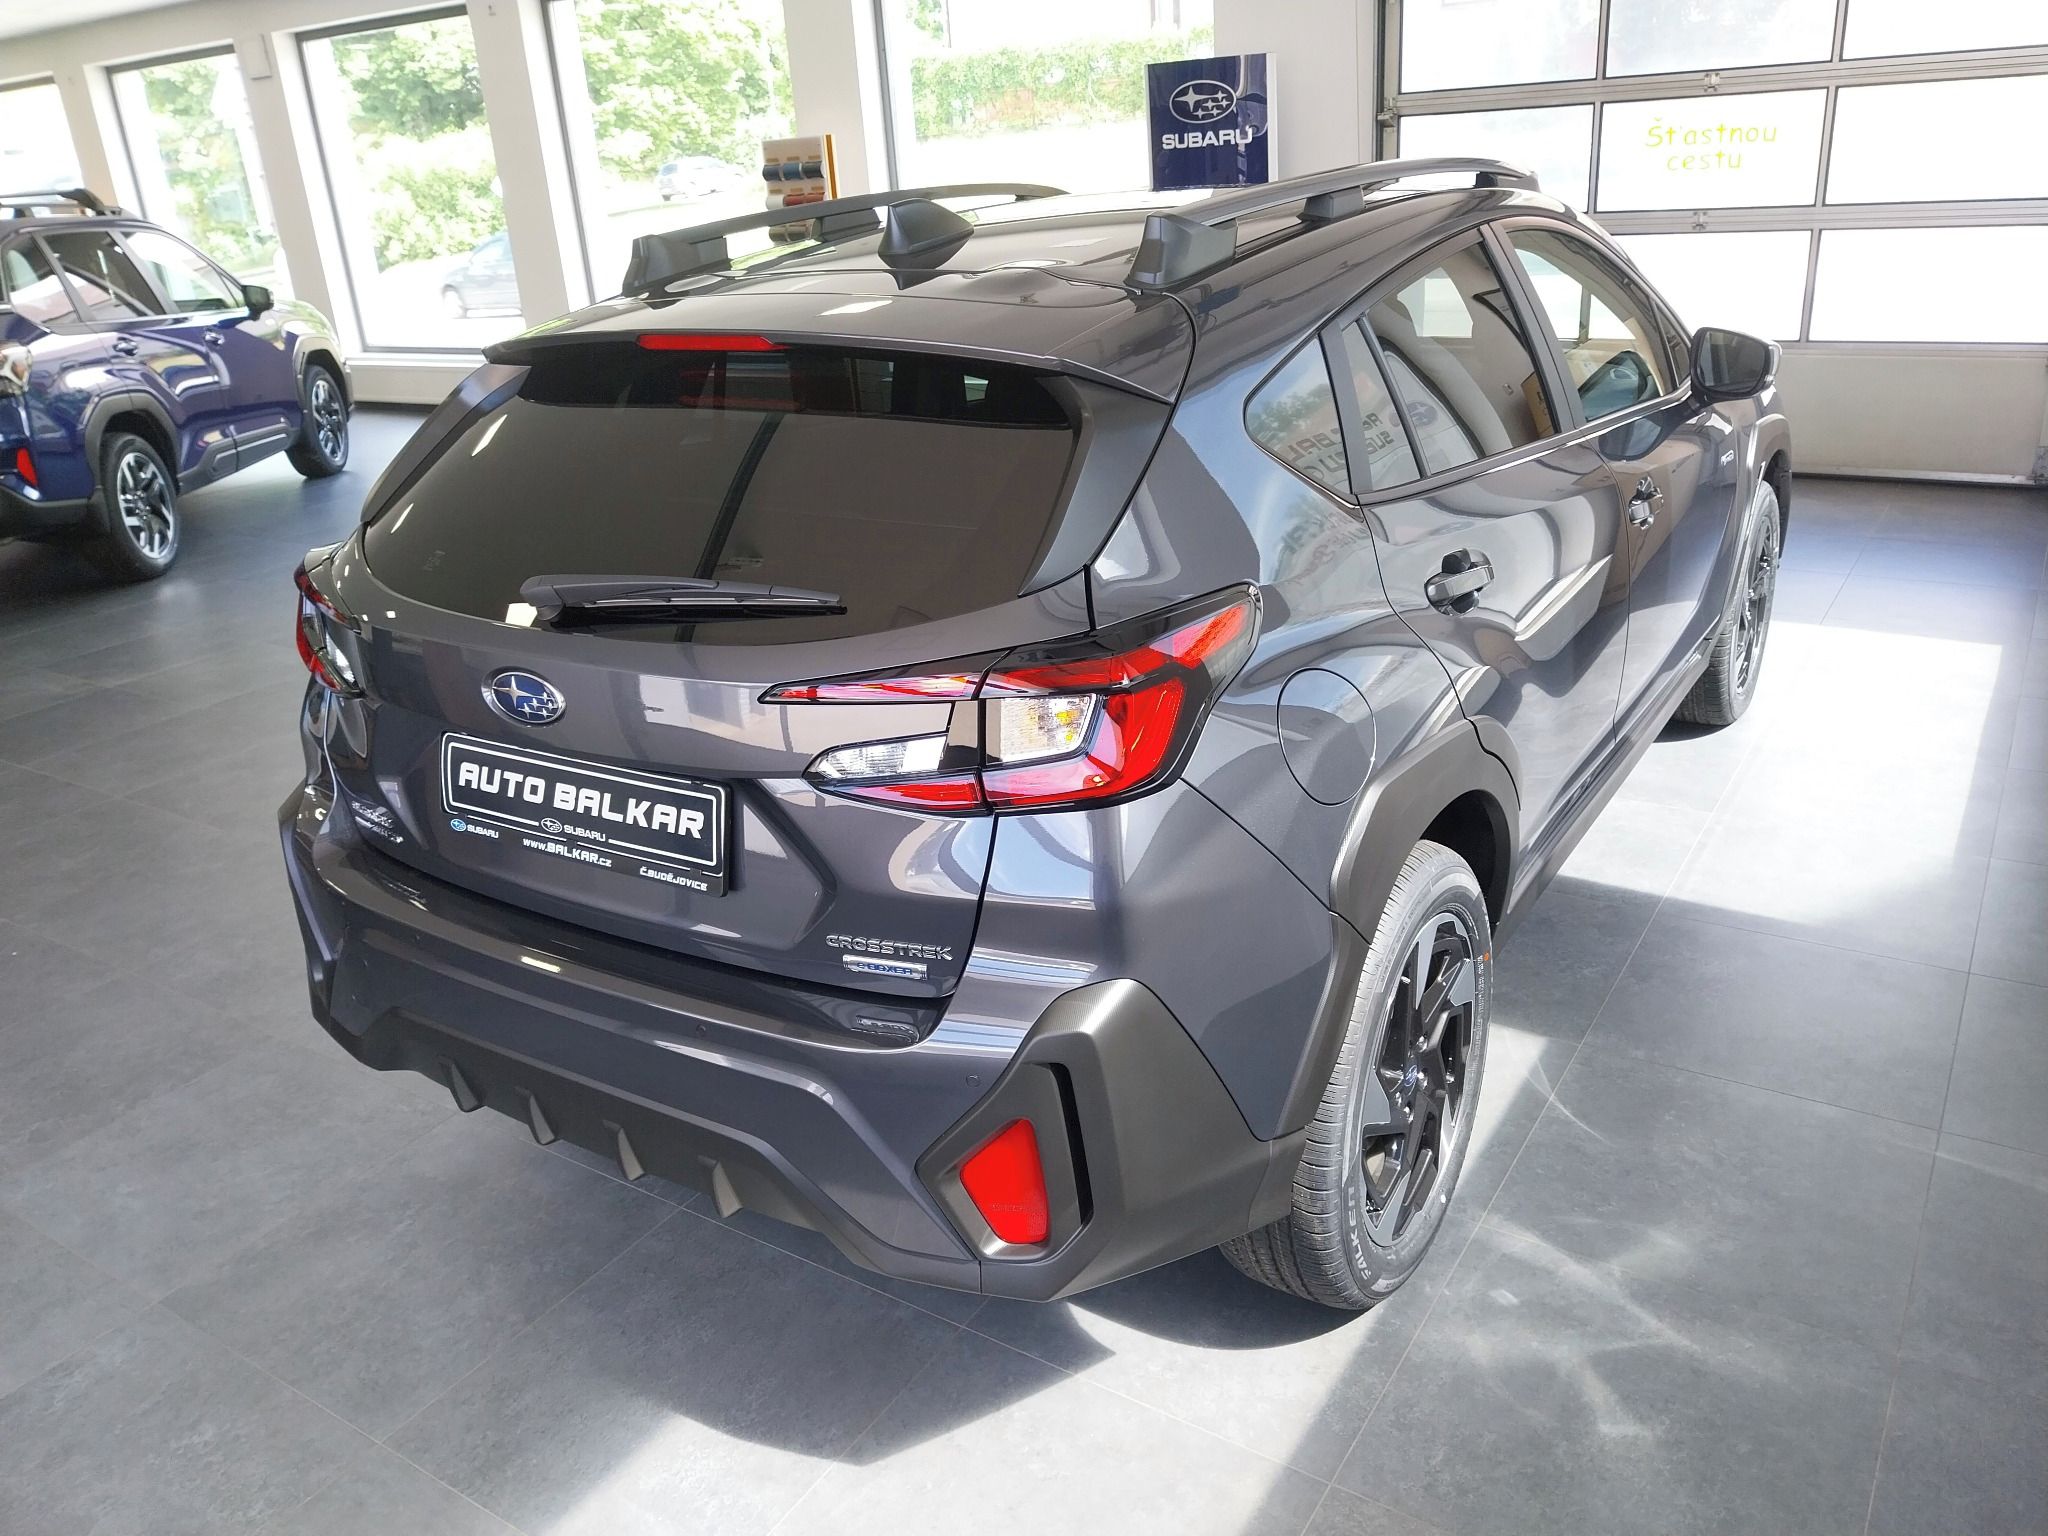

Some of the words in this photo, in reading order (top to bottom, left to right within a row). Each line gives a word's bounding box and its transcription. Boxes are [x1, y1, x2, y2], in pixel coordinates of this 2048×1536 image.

[1162, 126, 1253, 150] SUBARU
[1667, 150, 1741, 171] cestu
[458, 761, 545, 804] AUTO
[553, 782, 705, 839] BALKAR
[467, 824, 499, 839] SUBARU
[564, 824, 606, 842] SUBARU
[825, 934, 953, 961] CROSSTREK
